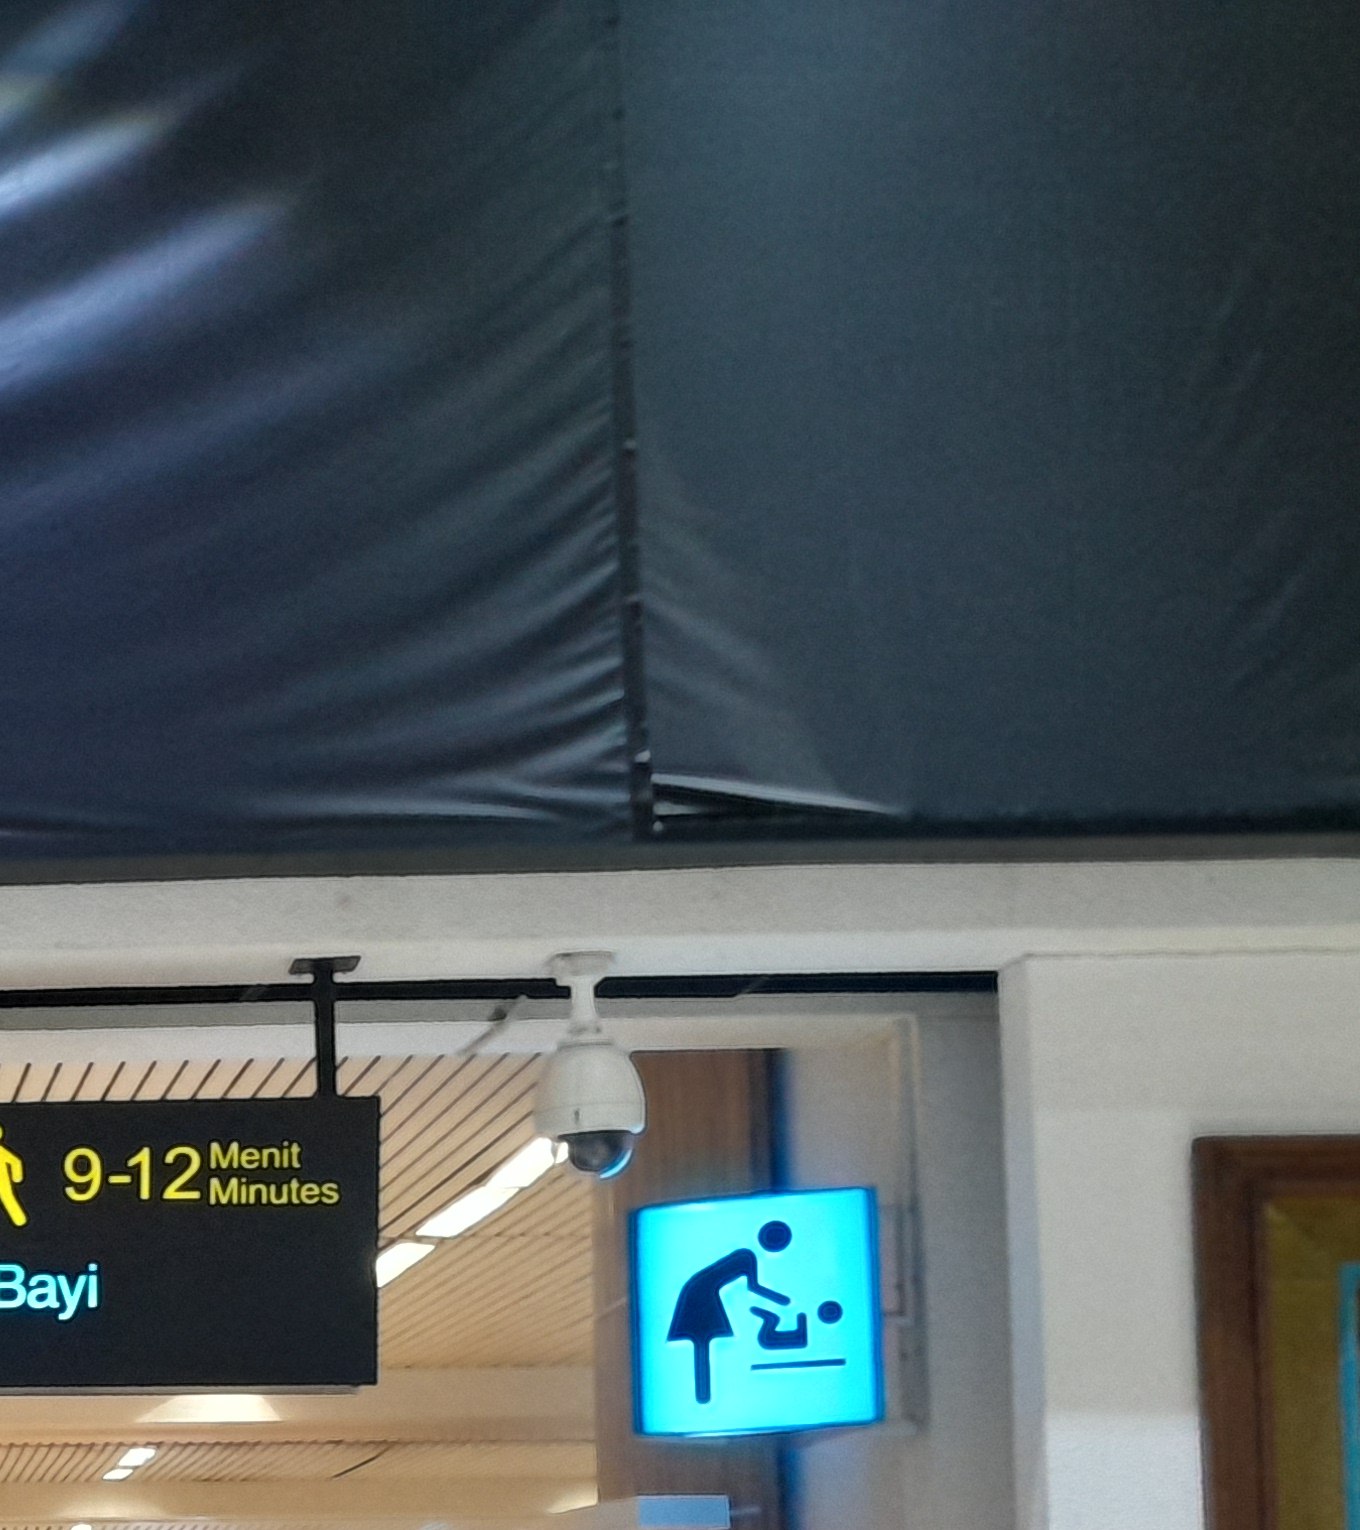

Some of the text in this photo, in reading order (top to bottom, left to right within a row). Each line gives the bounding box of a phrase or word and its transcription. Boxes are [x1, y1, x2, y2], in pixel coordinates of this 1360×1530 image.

[210, 1141, 301, 1169] Menit
[64, 1146, 201, 1202] 9-12
[209, 1177, 340, 1205] Minutes
